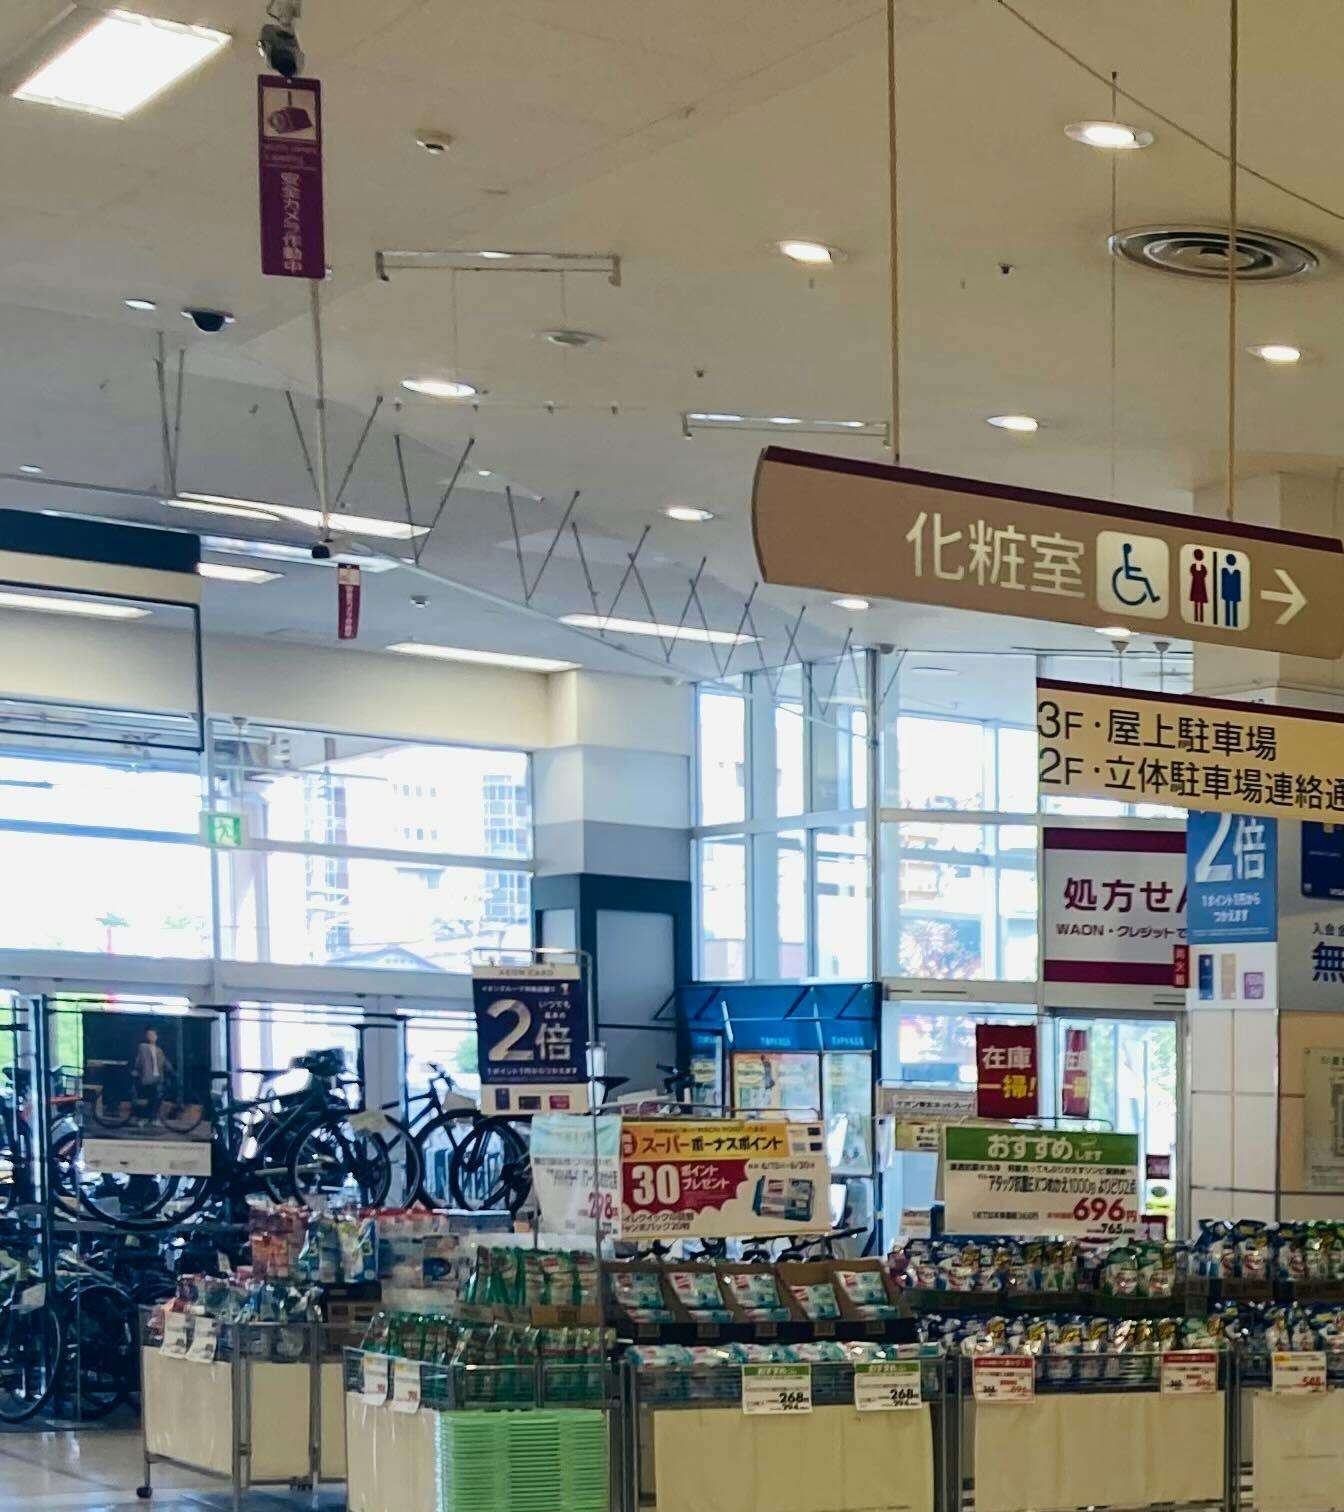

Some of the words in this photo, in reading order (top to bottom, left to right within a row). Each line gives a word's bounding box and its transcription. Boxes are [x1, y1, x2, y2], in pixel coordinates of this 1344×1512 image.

[906, 512, 1086, 599] 化粧室
[487, 999, 573, 1062] 2倍
[982, 1045, 1032, 1070] 在庫
[631, 1164, 680, 1206] 30
[681, 1164, 719, 1177] ポイント
